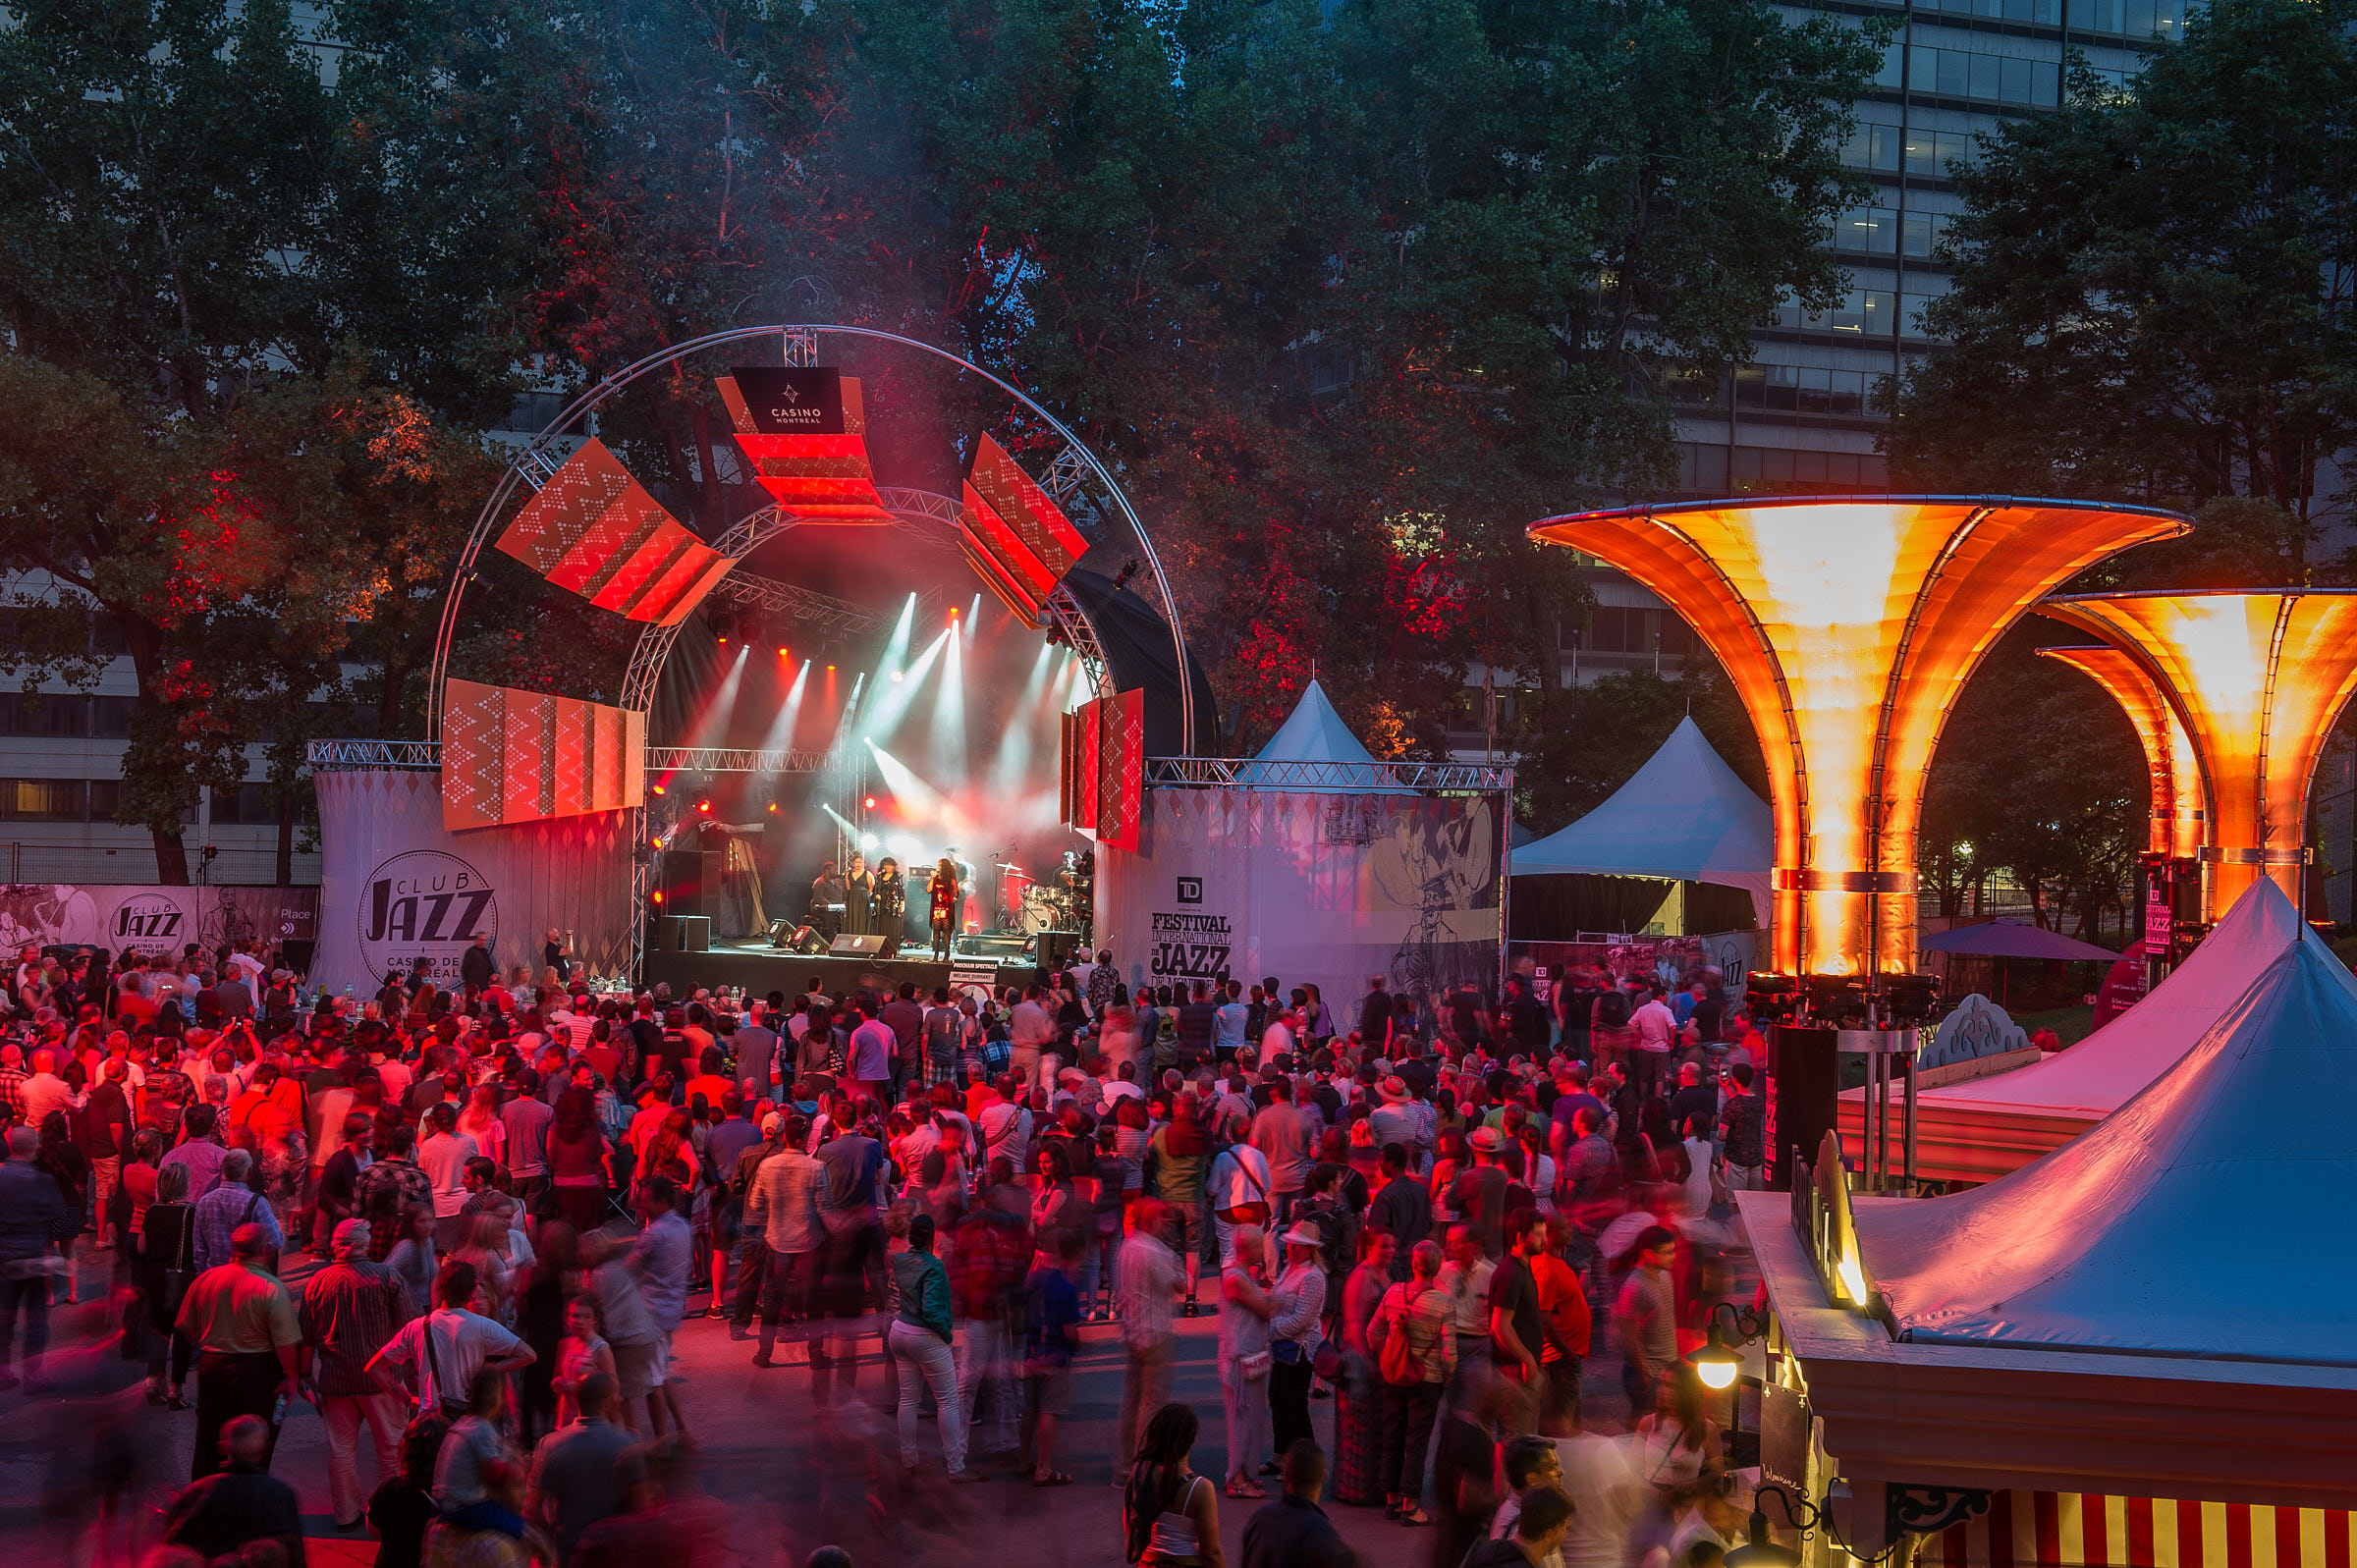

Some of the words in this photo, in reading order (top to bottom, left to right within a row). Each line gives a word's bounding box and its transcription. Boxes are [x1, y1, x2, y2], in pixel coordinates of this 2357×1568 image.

[397, 872, 469, 894] CLUB
[1178, 880, 1201, 900] TD
[134, 903, 172, 914] CLUB
[281, 909, 311, 919] Place
[365, 878, 495, 942] JAZZ
[115, 906, 184, 937] JAZZ
[1151, 912, 1232, 934] FESTIVAL
[1151, 930, 1232, 946] INTERNATIONAL
[387, 957, 437, 966] CASIO
[442, 957, 460, 966] DE
[1151, 943, 1231, 978] JAZZ
